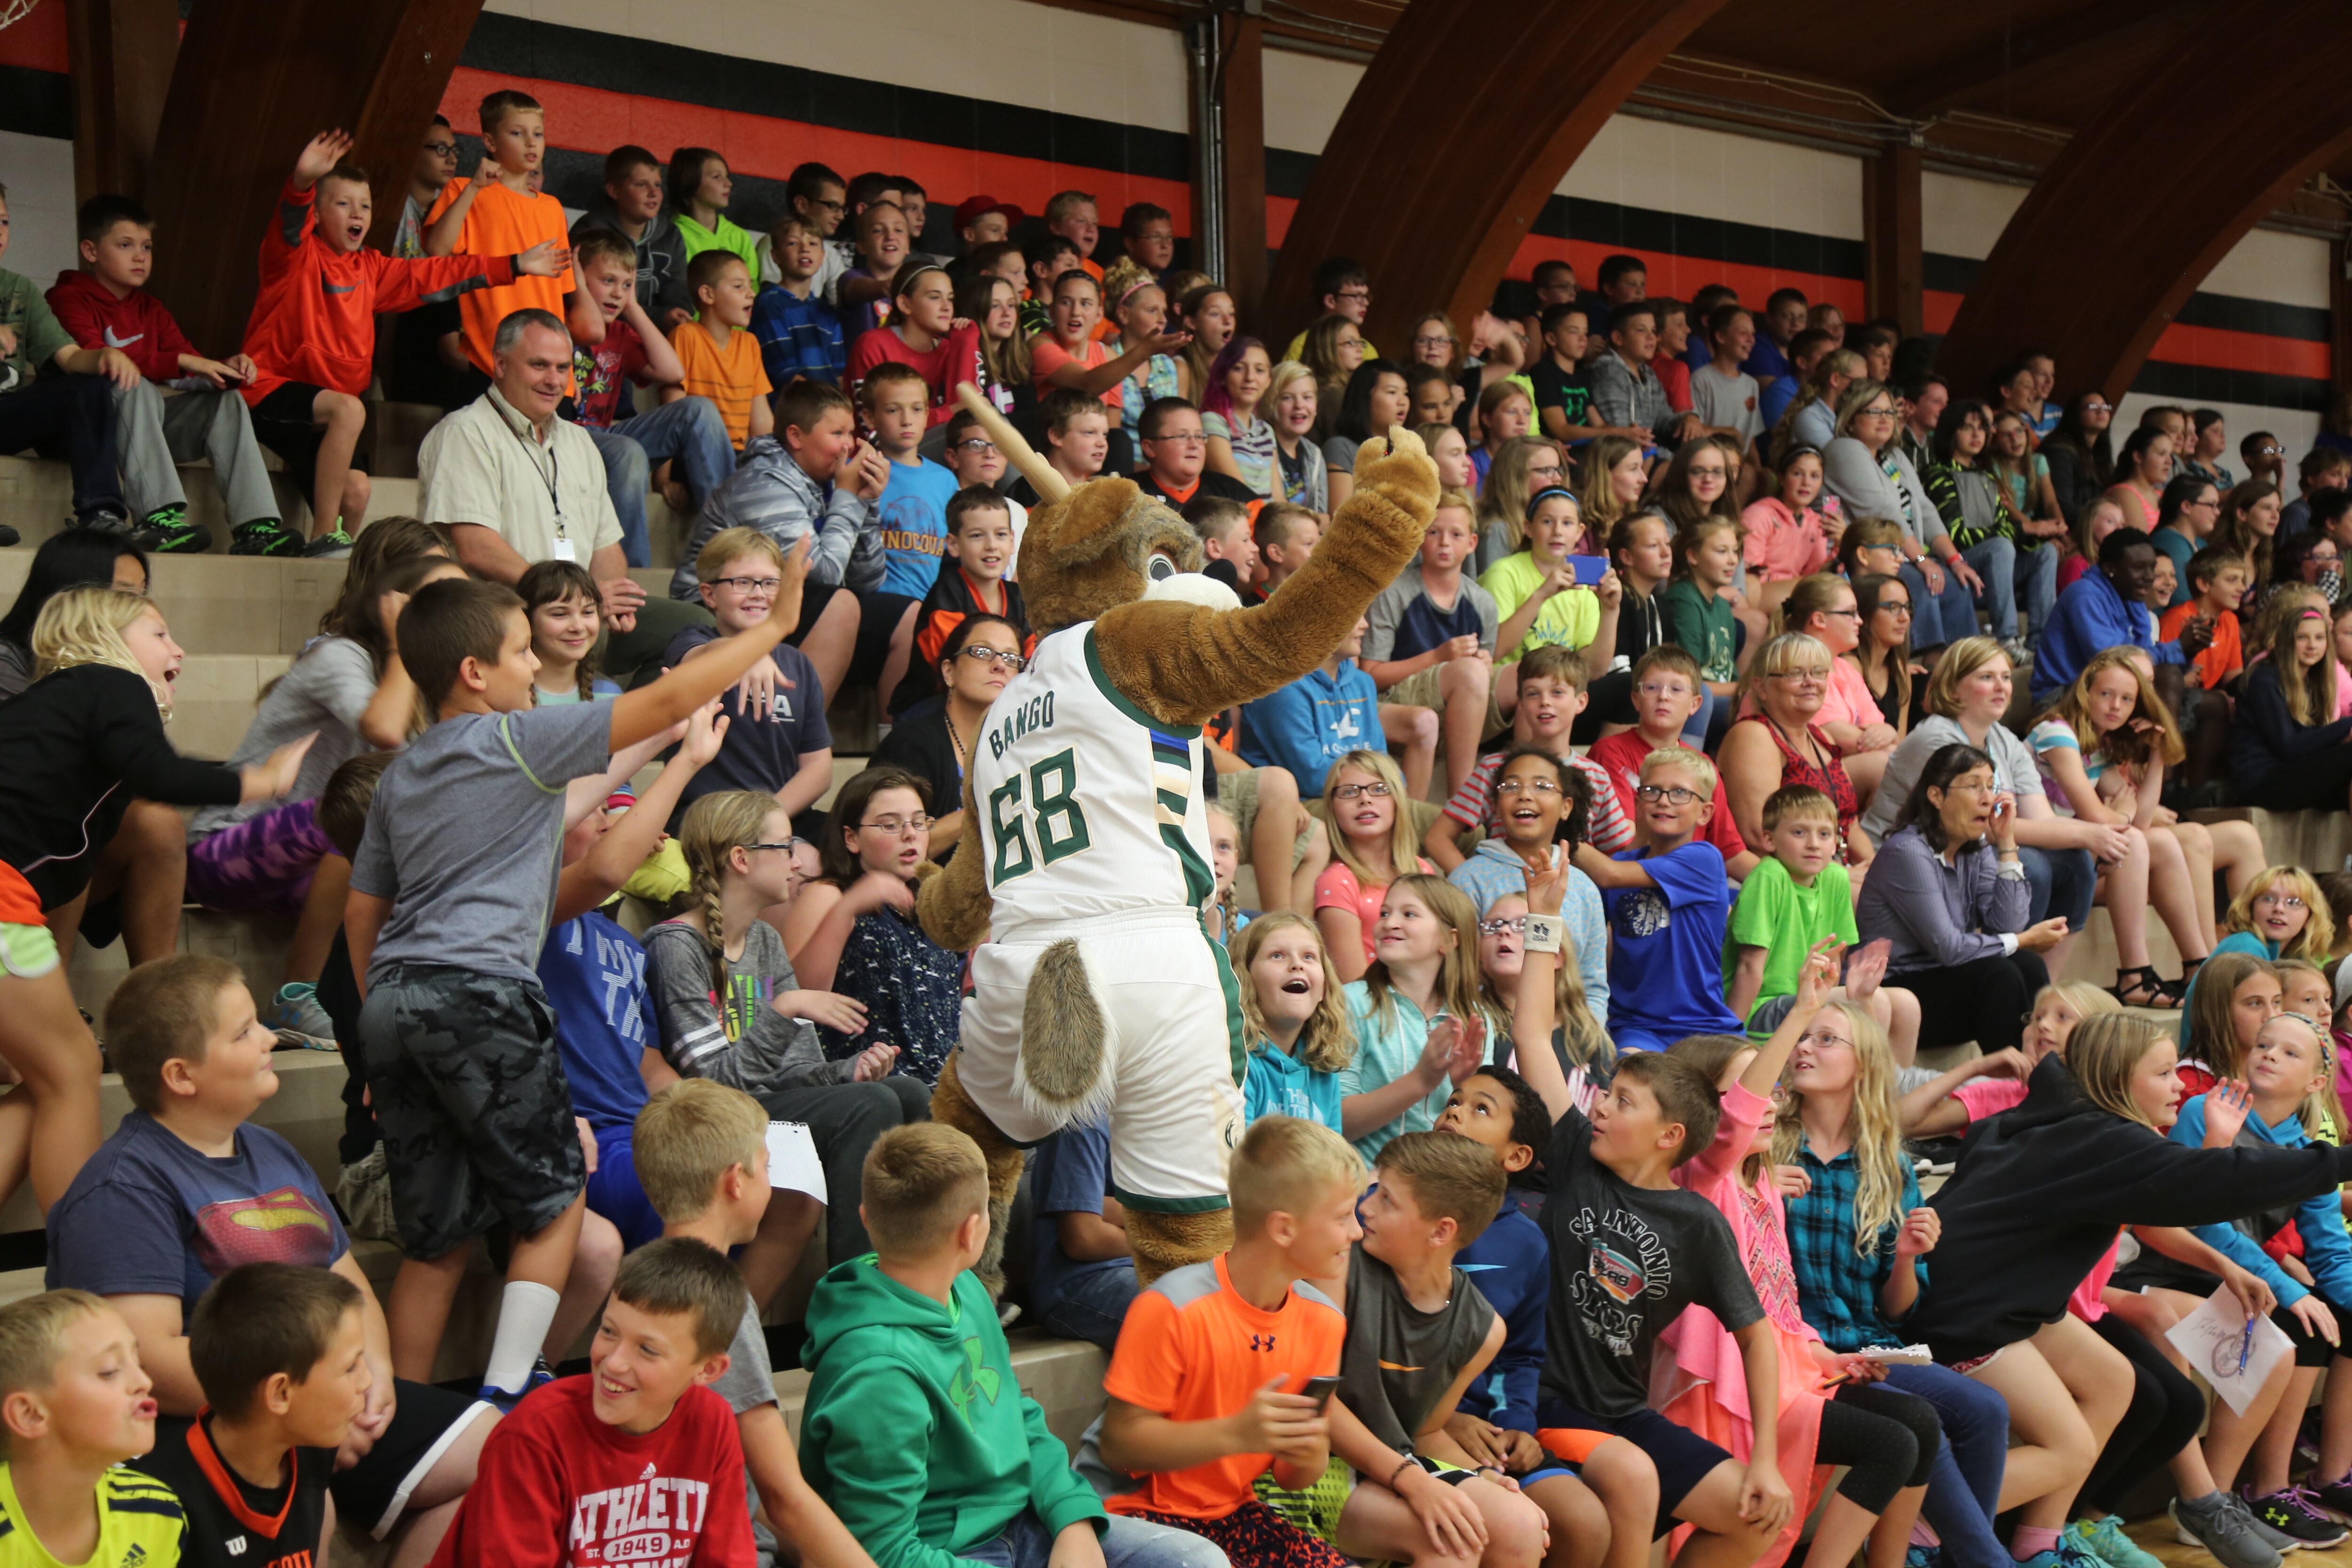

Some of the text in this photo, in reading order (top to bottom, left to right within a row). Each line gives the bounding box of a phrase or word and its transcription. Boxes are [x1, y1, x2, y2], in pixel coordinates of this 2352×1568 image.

[989, 690, 1055, 762] BANGO
[989, 743, 1094, 892] 68
[569, 1477, 709, 1552] ATHLETI
[612, 1537, 663, 1558] 1949
